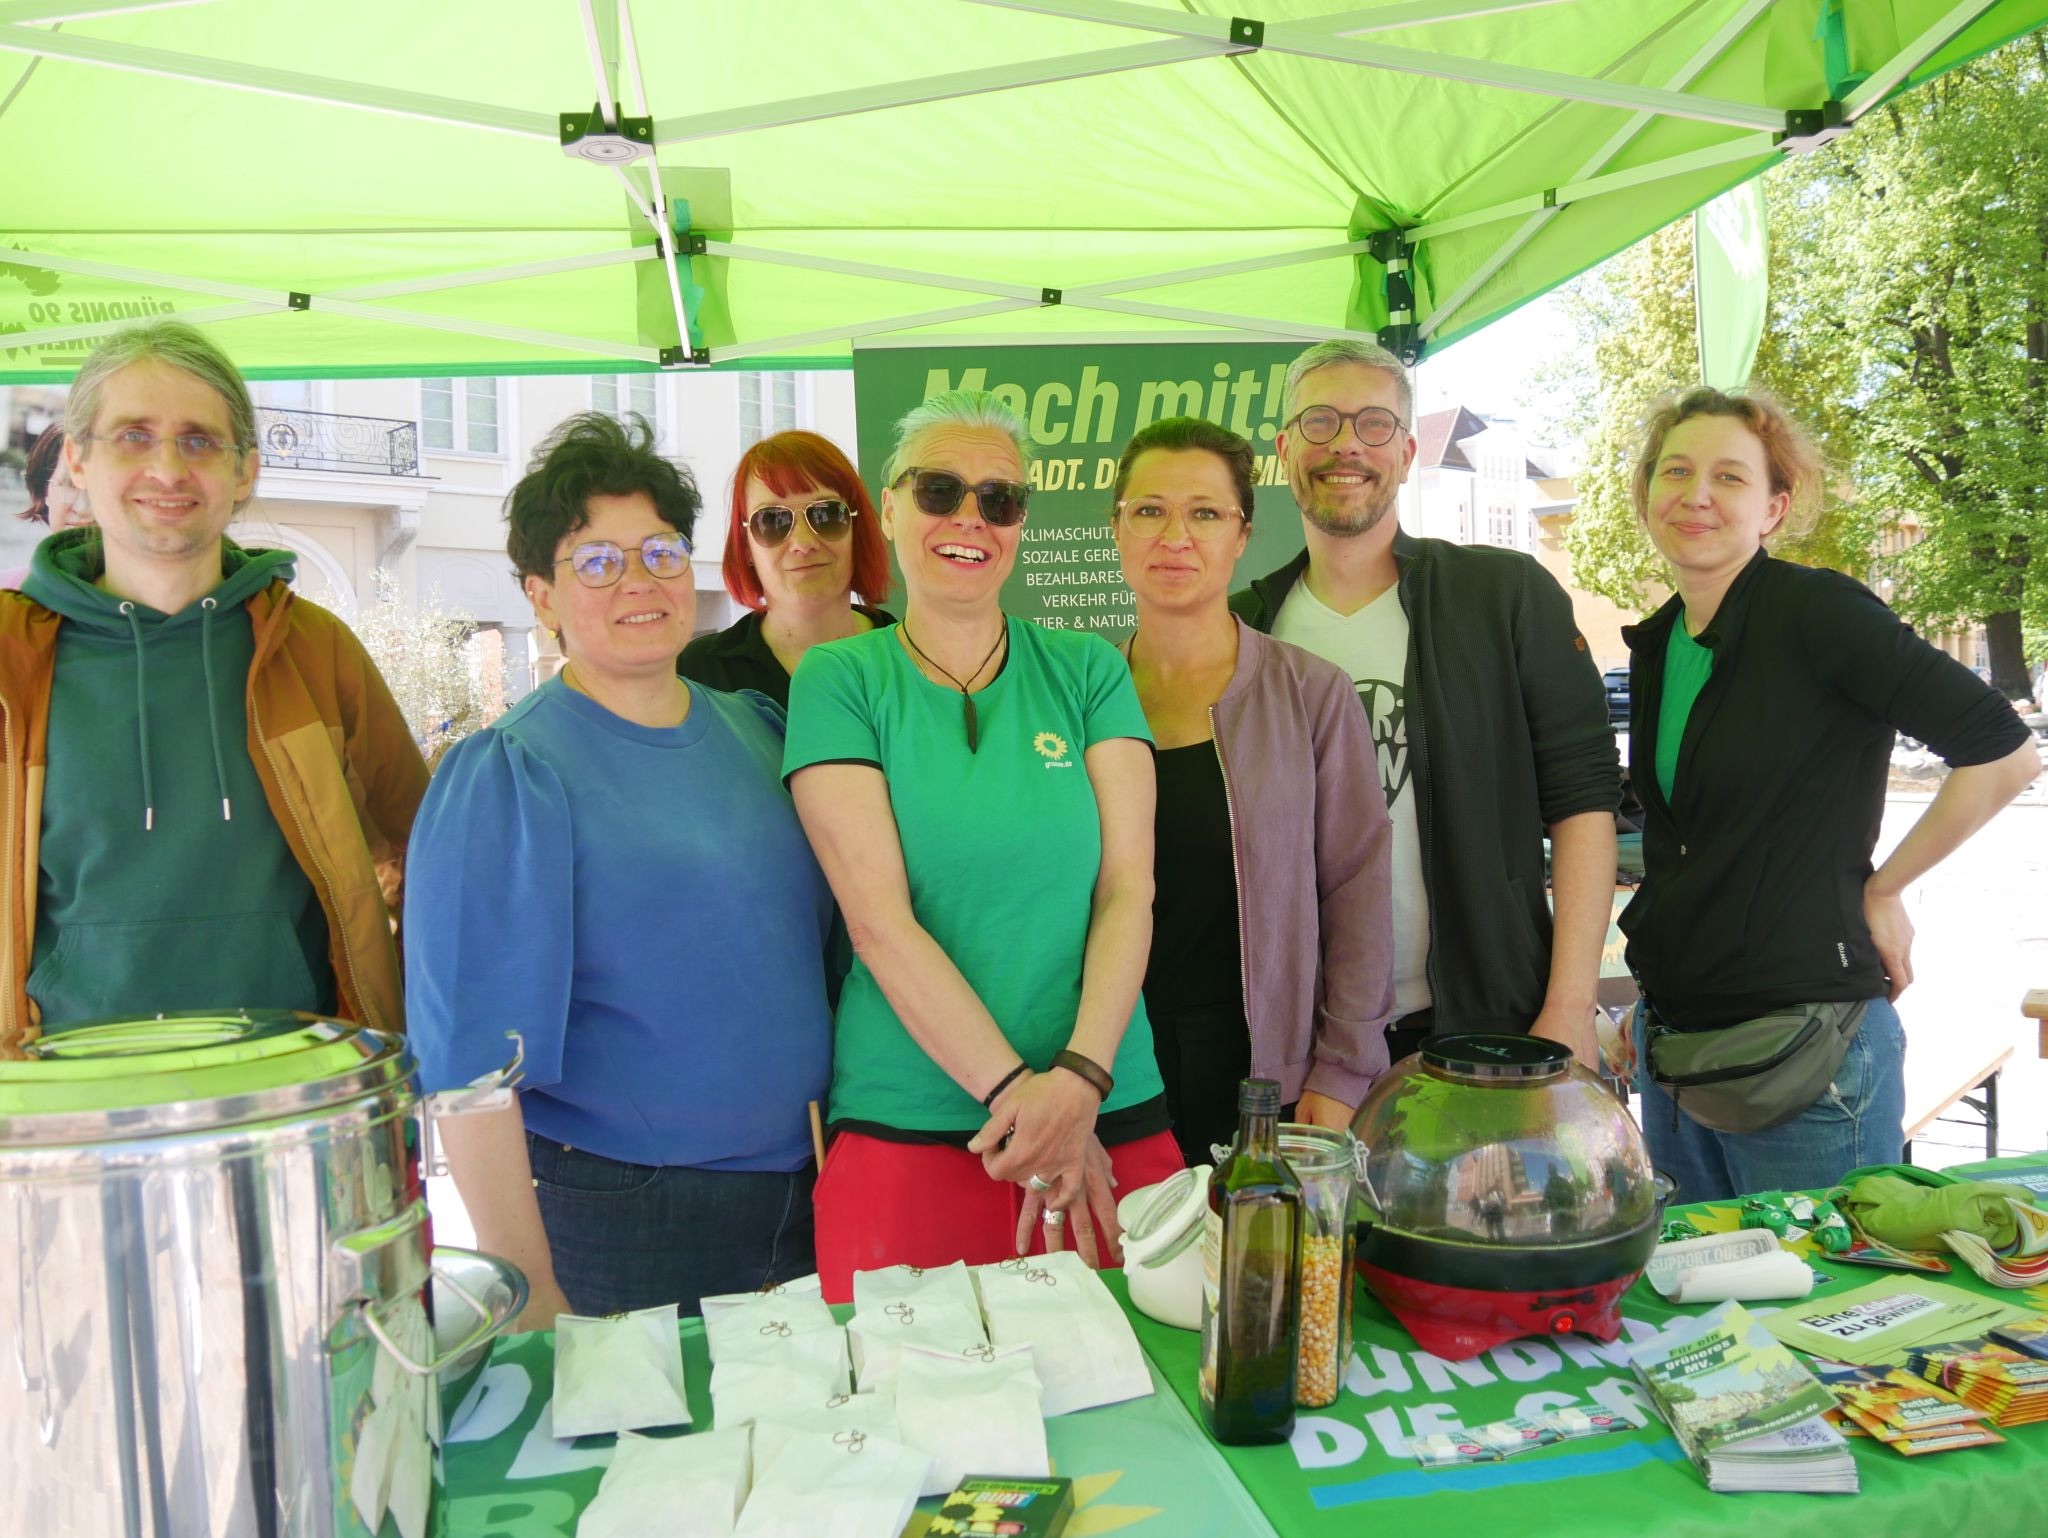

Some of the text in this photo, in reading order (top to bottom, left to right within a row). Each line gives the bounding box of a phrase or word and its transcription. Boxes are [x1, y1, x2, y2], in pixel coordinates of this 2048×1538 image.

[1134, 362, 1287, 441] mit!
[1028, 459, 1085, 491] ADT.
[1023, 549, 1119, 564] SOZIALE GERE
[1026, 571, 1124, 586] BEZAHLBARES
[1042, 590, 1137, 608] VERKEHR FÜR
[1033, 616, 1069, 630] TIER-
[1074, 616, 1084, 628] &
[1651, 1247, 1714, 1273] SUPPORT
[1800, 1310, 1860, 1328] Eine
[1830, 1299, 1935, 1336] zu gewinnen
[1665, 1340, 1730, 1370] grüneres
[1669, 1334, 1719, 1357] Für ein
[1684, 1359, 1713, 1374] MV.
[1723, 1403, 1819, 1441] gruene-rostock.de
[975, 1491, 1029, 1505] BUNT
